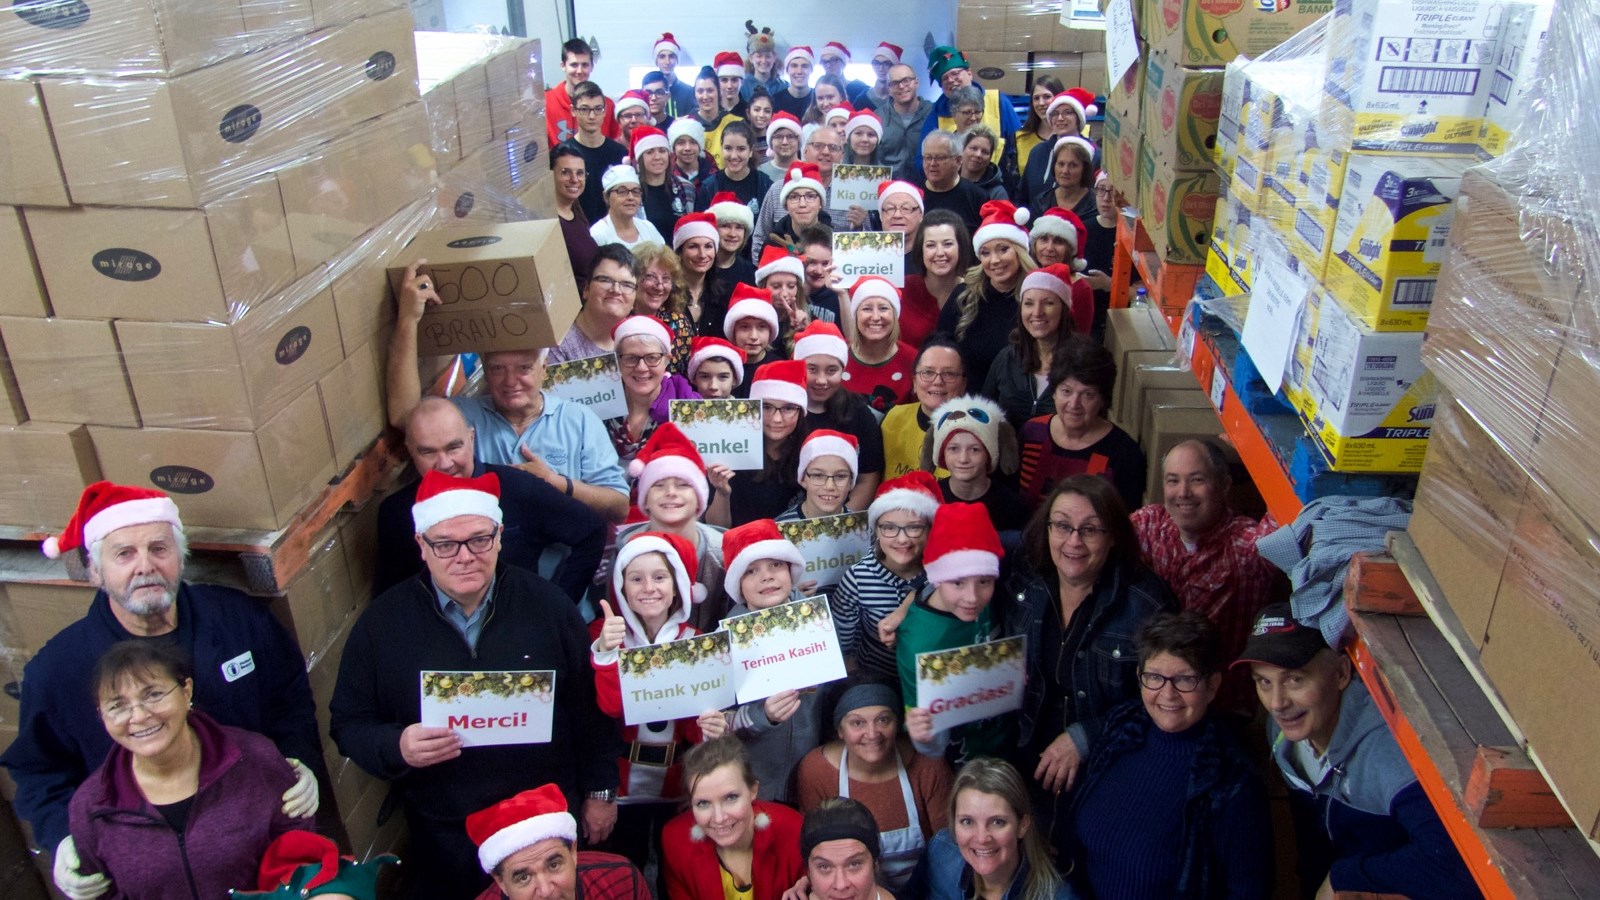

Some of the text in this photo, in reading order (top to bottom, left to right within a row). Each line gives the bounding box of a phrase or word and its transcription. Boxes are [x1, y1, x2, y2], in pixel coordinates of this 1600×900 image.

[1415, 13, 1452, 22] TRIPLE
[224, 114, 257, 133] mirage
[1400, 121, 1439, 138] Sunlight
[837, 190, 854, 200] Kia
[100, 260, 153, 271] mirage
[842, 263, 893, 275] Grazie!
[431, 262, 518, 305] 500
[425, 312, 528, 347] BRAVO
[279, 334, 307, 357] mirage
[1385, 428, 1431, 438] TRIPLE
[156, 475, 206, 486] mirage
[805, 550, 862, 573] ahola!
[741, 640, 827, 672] Terima Kasih!
[631, 672, 727, 703] Thank you!
[929, 682, 1015, 716] Gracias!
[447, 712, 528, 730] Merci!
